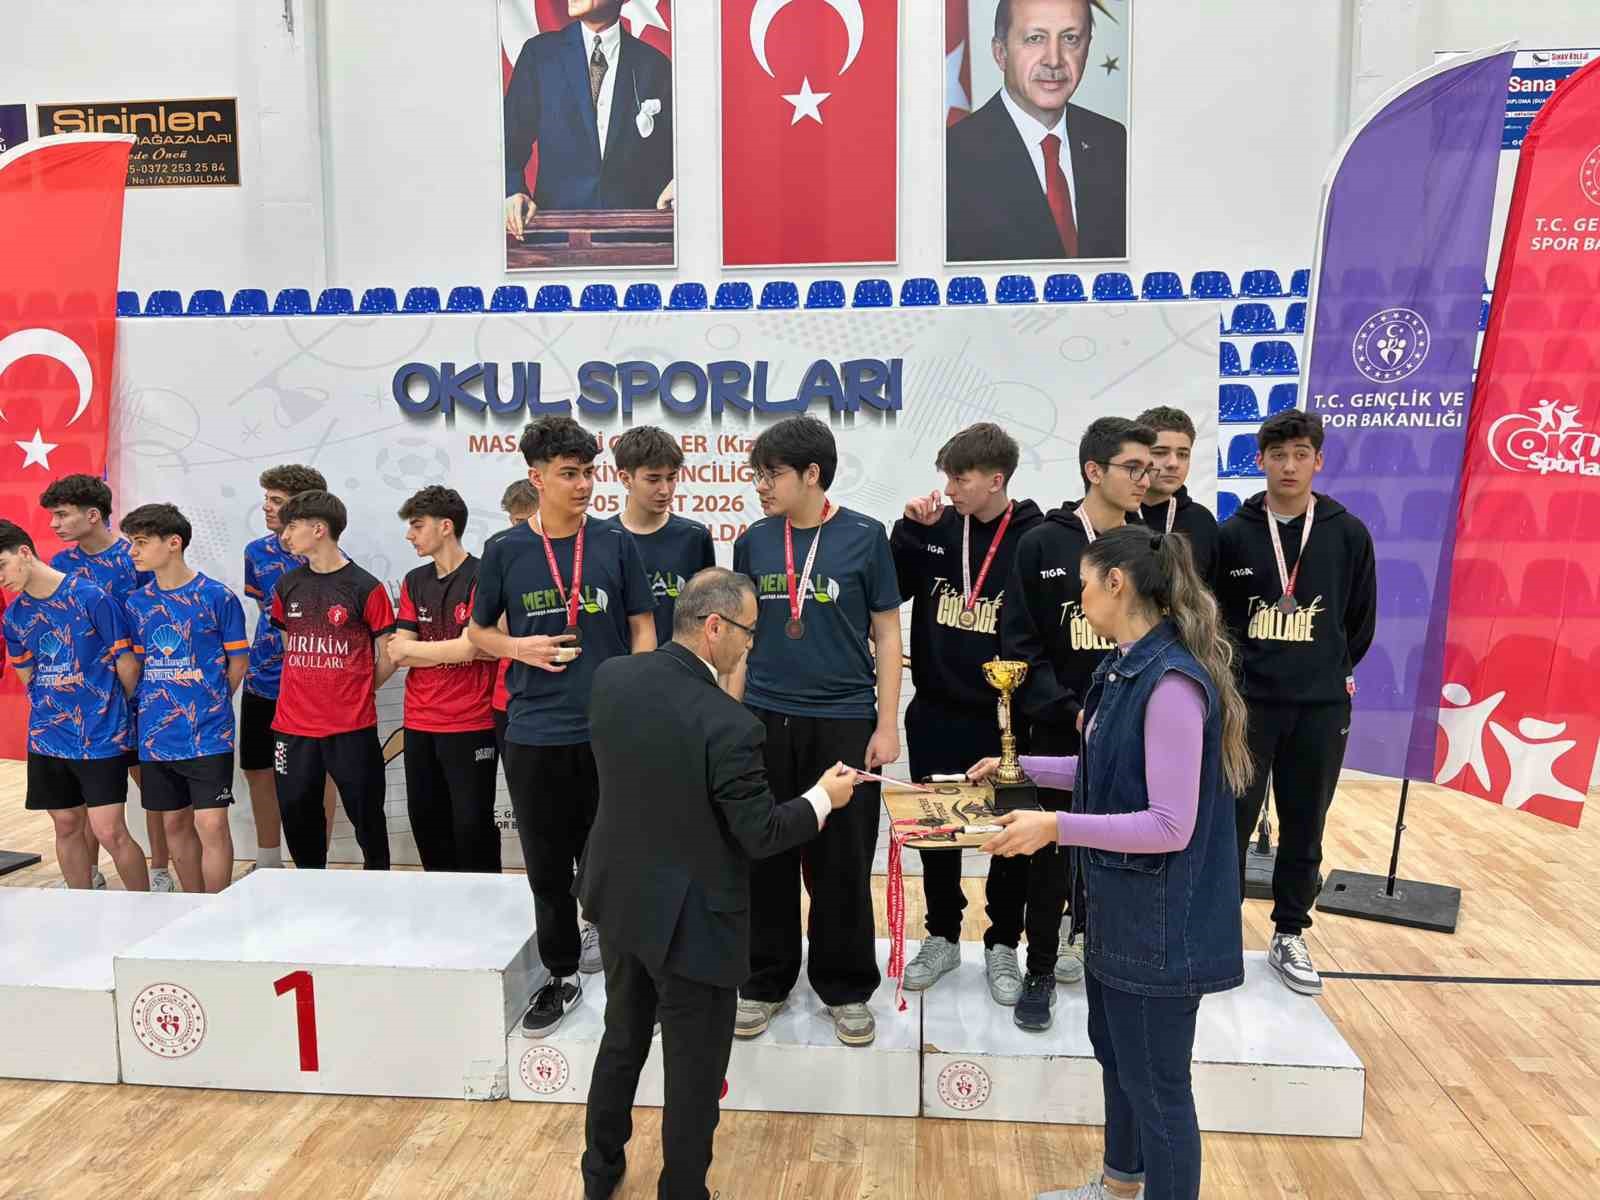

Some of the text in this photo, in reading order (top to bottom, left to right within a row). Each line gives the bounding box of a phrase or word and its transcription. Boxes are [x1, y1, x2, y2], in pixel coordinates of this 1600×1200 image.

[128, 162, 225, 174] 5-0372 253 25 84
[166, 175, 226, 184] ZONGULDAK
[1535, 217, 1567, 232] T.C.
[1531, 237, 1579, 251] SPOR
[392, 357, 904, 415] OKUL SPORLARI
[1314, 389, 1464, 410] T.C. GENÇLİK VE
[1321, 408, 1462, 428] POR BAKANLIĞI
[469, 434, 522, 452] MAS
[676, 461, 754, 483] NCİLİĞ
[1527, 452, 1600, 475] Sporla
[692, 495, 745, 512] 2026
[928, 544, 945, 555] IGA
[1040, 568, 1067, 579] TIGA
[289, 655, 344, 668] OKULLARI
[273, 970, 319, 1072] 1
